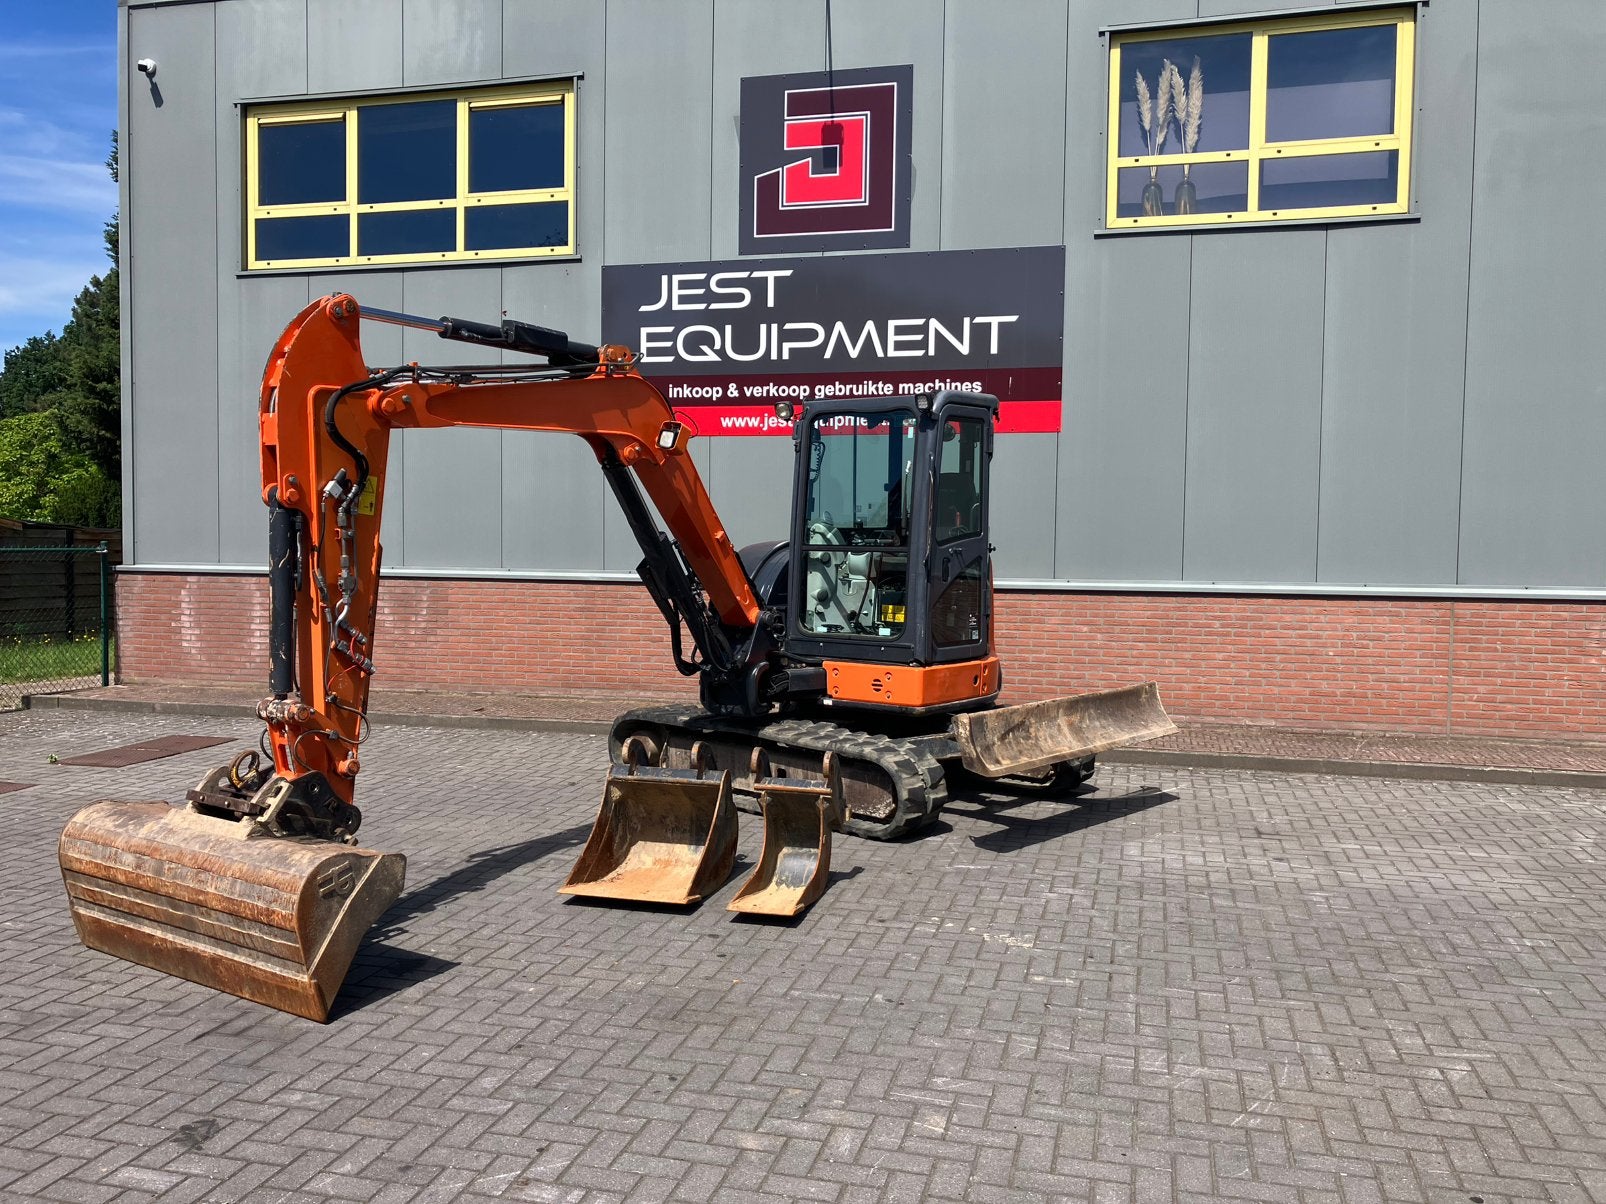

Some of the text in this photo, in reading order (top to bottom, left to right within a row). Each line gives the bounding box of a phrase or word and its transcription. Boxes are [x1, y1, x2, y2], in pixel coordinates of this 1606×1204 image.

[638, 270, 793, 312] JEST
[639, 314, 1020, 363] EQUIPMENT
[668, 378, 983, 402] inkoop & verkoop gebruikte machines
